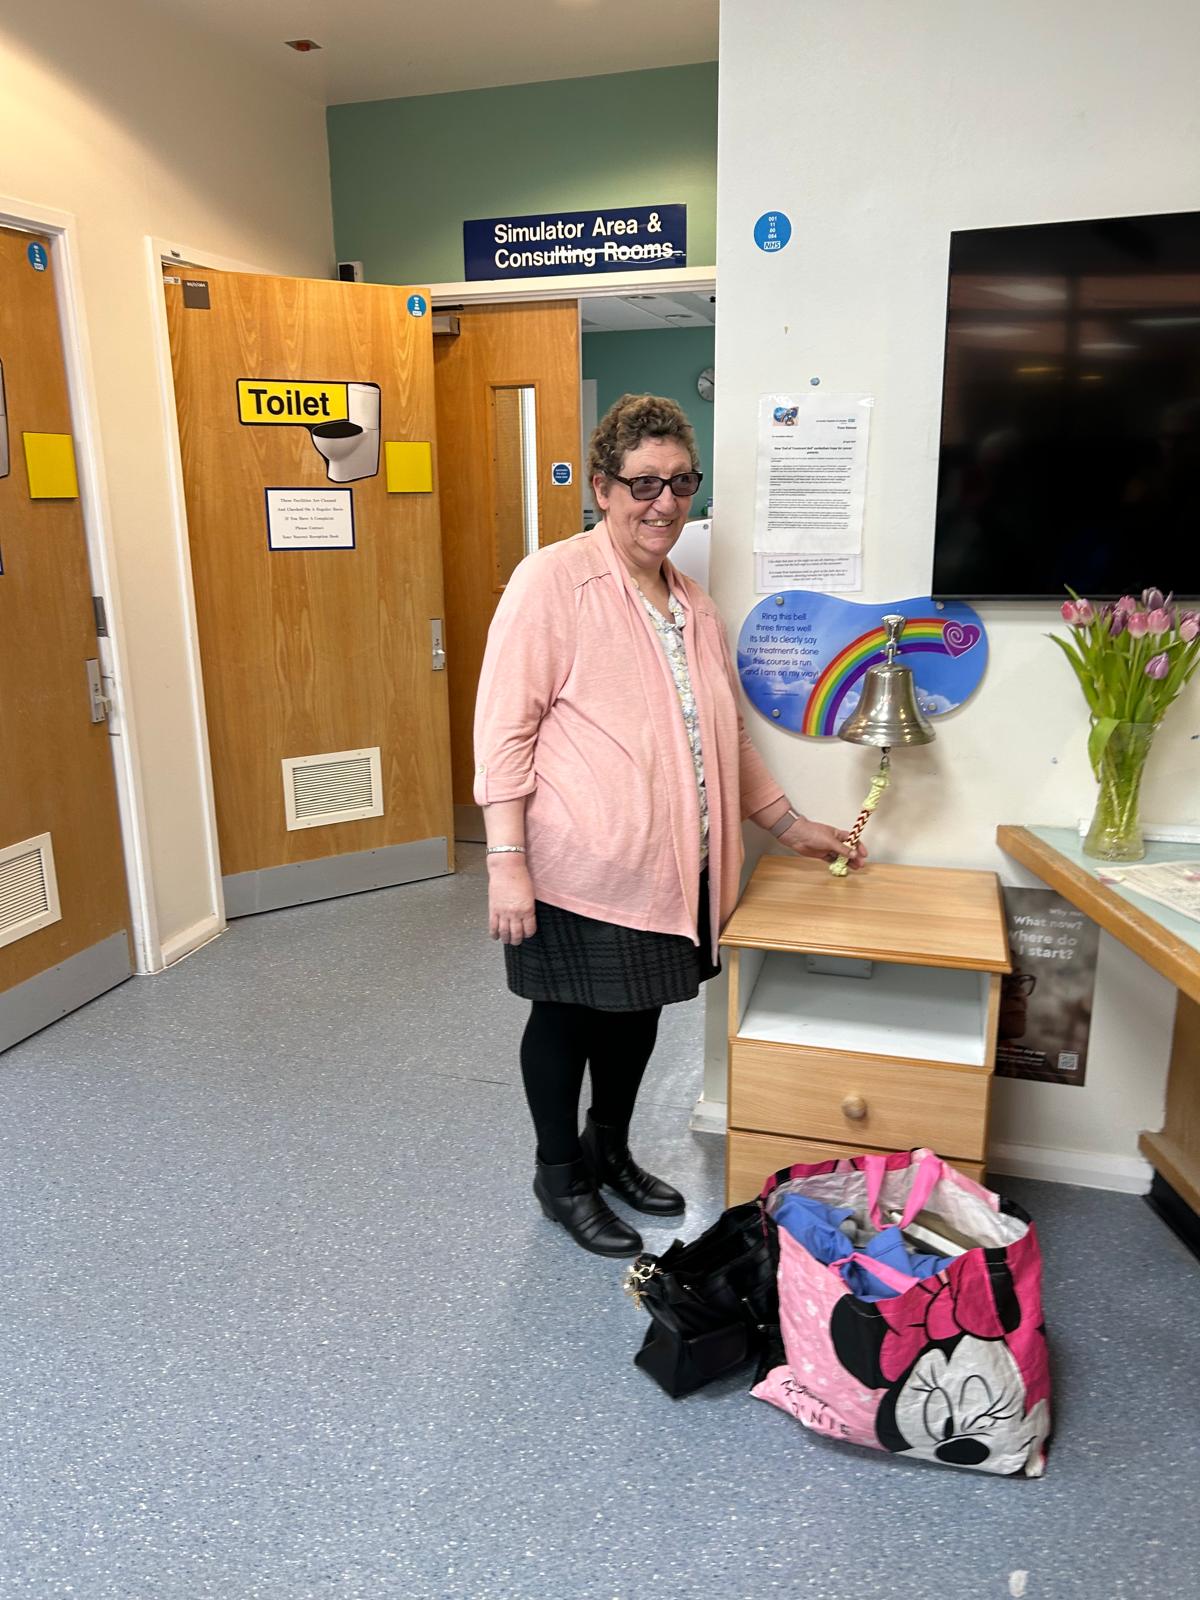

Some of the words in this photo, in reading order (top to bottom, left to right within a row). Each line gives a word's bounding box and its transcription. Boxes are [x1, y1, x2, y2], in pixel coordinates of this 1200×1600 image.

[494, 220, 584, 244] Simulator
[592, 216, 638, 237] Area
[647, 212, 662, 233] &
[495, 246, 596, 269] Consulting
[604, 241, 673, 261] Rooms
[248, 389, 330, 416] Toilet
[762, 613, 777, 621] Ring
[780, 636, 802, 644] clearly
[804, 637, 817, 645] say
[1013, 915, 1047, 927] What
[1049, 921, 1084, 930] now?
[1057, 934, 1077, 946] do
[1019, 945, 1025, 955] I
[1027, 946, 1074, 959] start?
